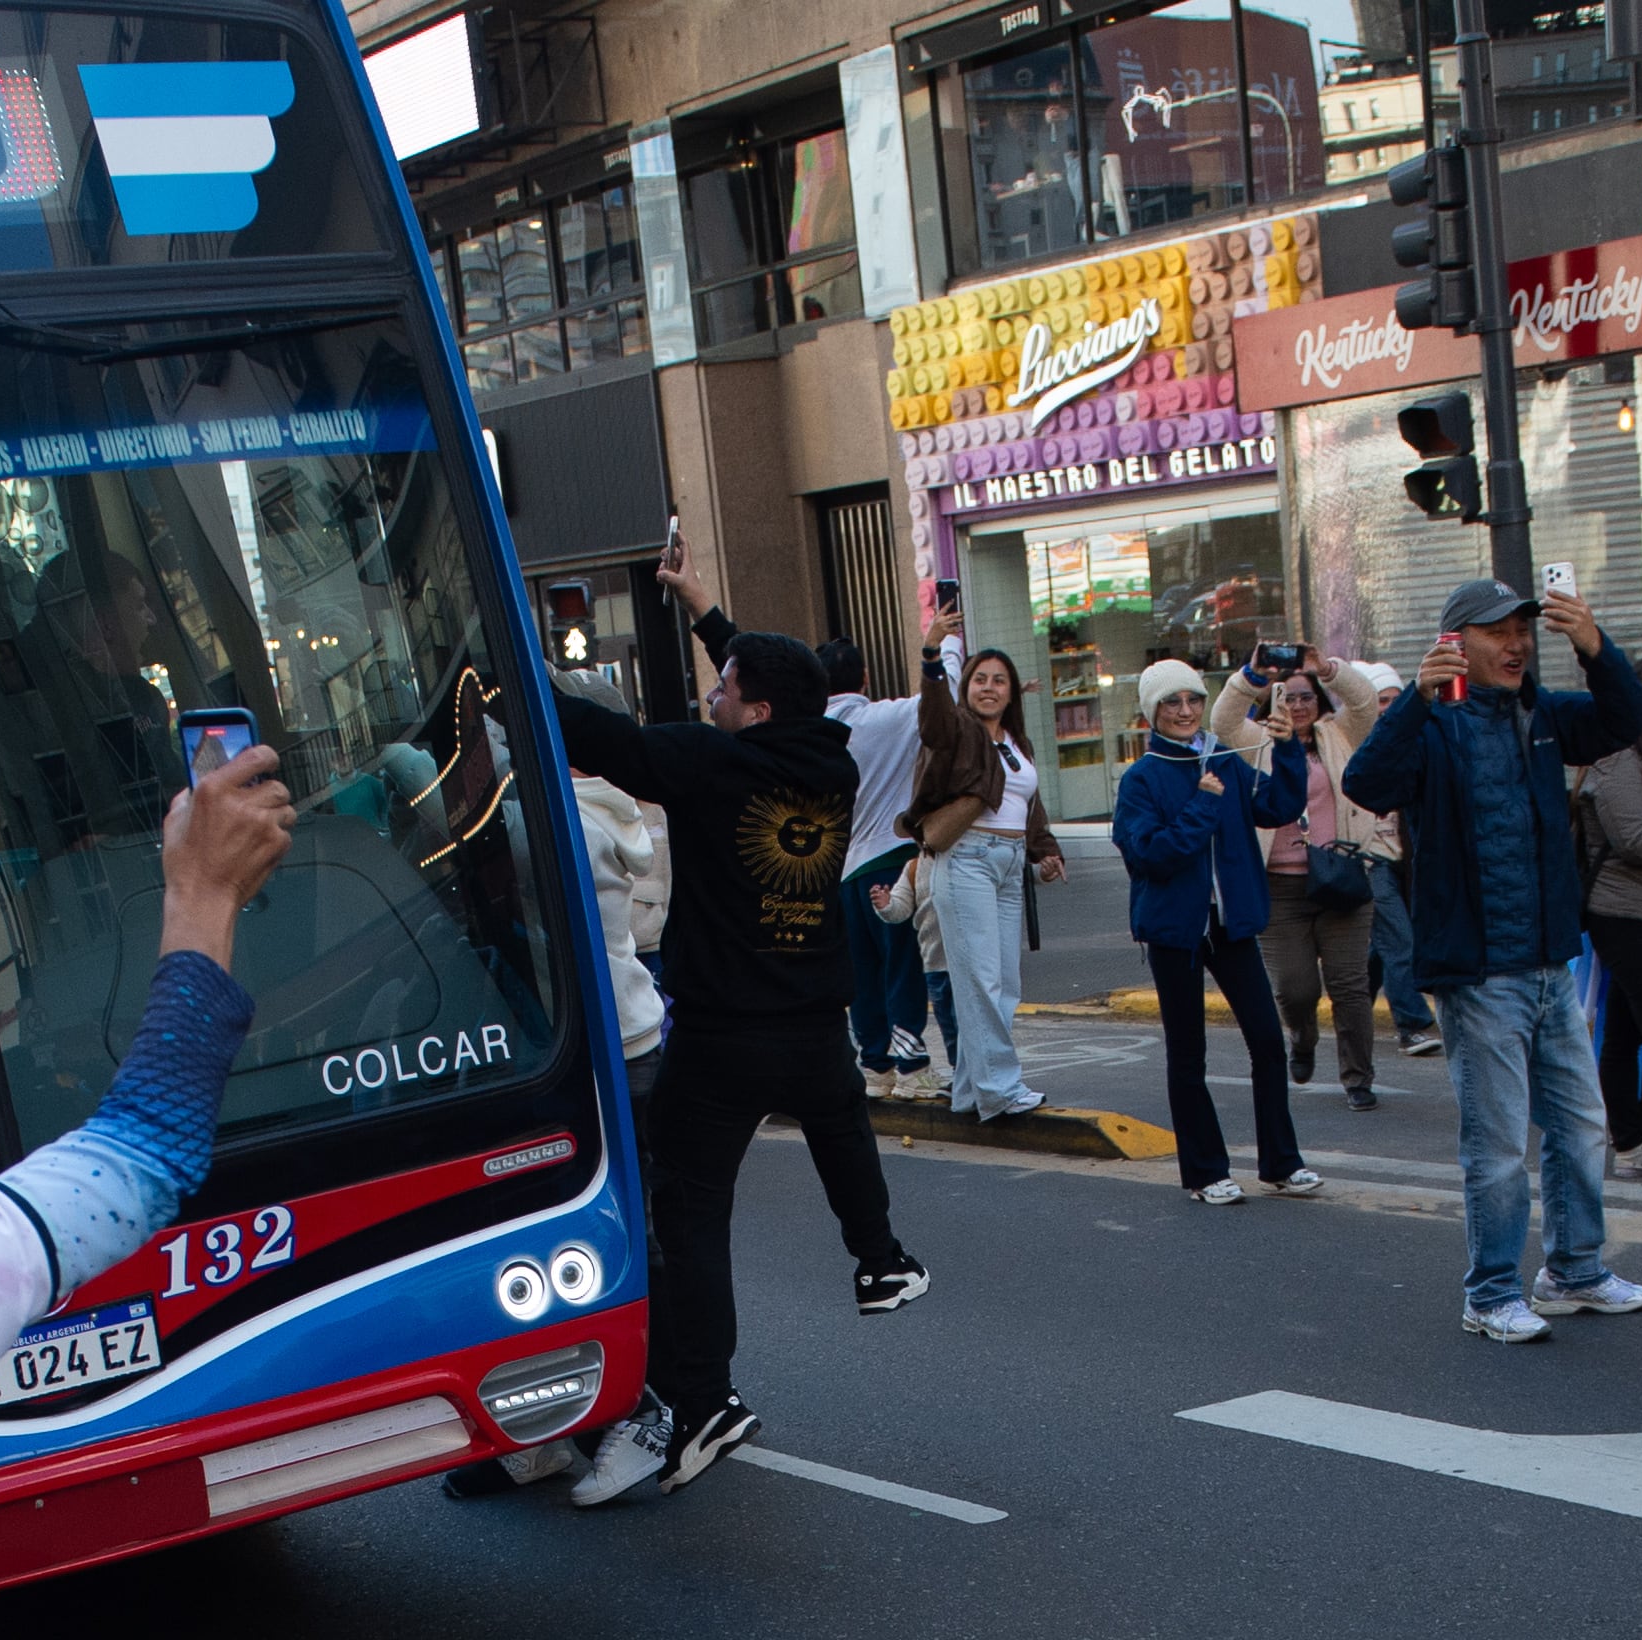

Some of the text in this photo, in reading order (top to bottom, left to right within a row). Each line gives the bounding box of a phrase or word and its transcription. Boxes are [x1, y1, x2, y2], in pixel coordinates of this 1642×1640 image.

[1006, 297, 1161, 408] Lucciano's
[1295, 309, 1415, 389] Kentucky
[20, 432, 91, 472] ALBERDI
[96, 422, 193, 465] DIRECTORIO
[198, 418, 234, 455] SAN
[230, 415, 283, 451] PEDRO
[287, 408, 367, 446] CABALLITO
[953, 436, 1276, 509] IL MAESTRO DEL GELATO
[322, 1023, 512, 1096] COLCAR
[159, 1205, 297, 1300] 132
[12, 1339, 89, 1390] 024
[99, 1323, 151, 1371] EZ
[46, 1320, 96, 1340] ARGENTINA
